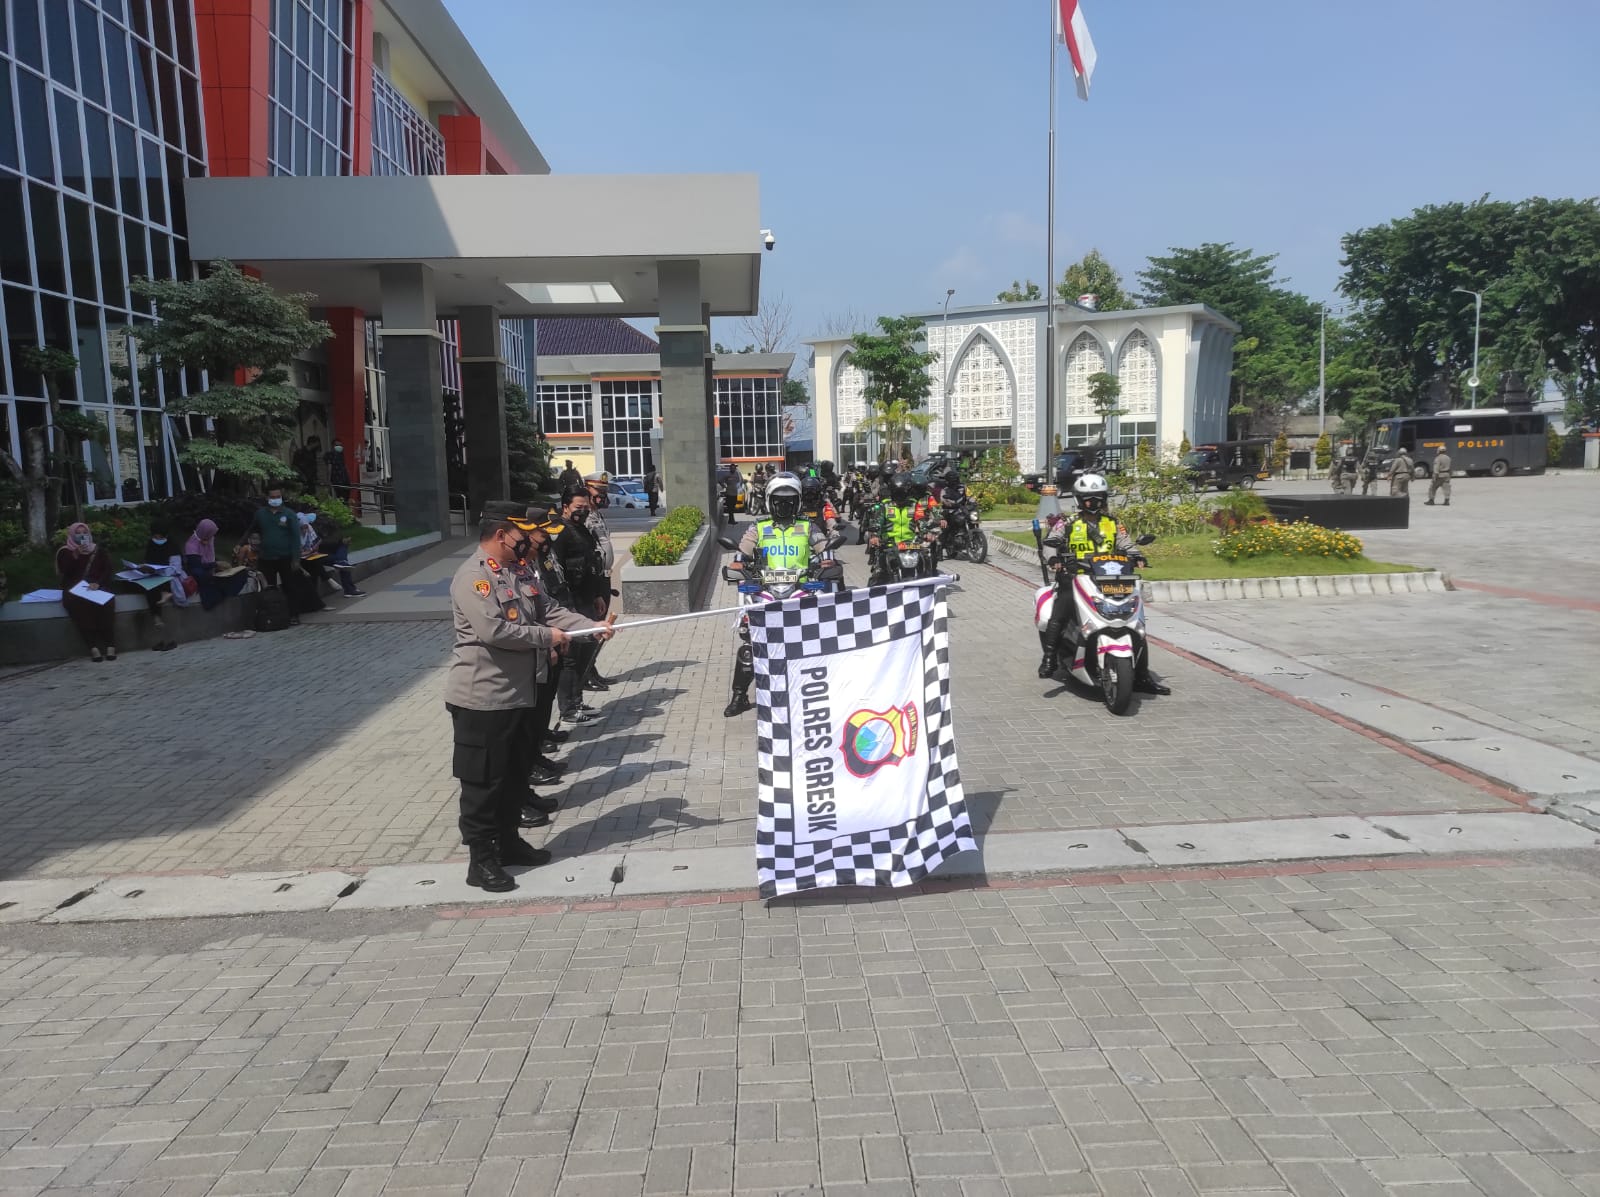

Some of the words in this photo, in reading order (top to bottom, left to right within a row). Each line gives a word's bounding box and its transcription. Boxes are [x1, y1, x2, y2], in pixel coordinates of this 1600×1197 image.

[1457, 439, 1504, 449] POLISI
[762, 545, 799, 558] POLISI
[1092, 555, 1128, 563] POLISI
[800, 666, 833, 751] POLRES
[804, 756, 838, 833] GRESIK
